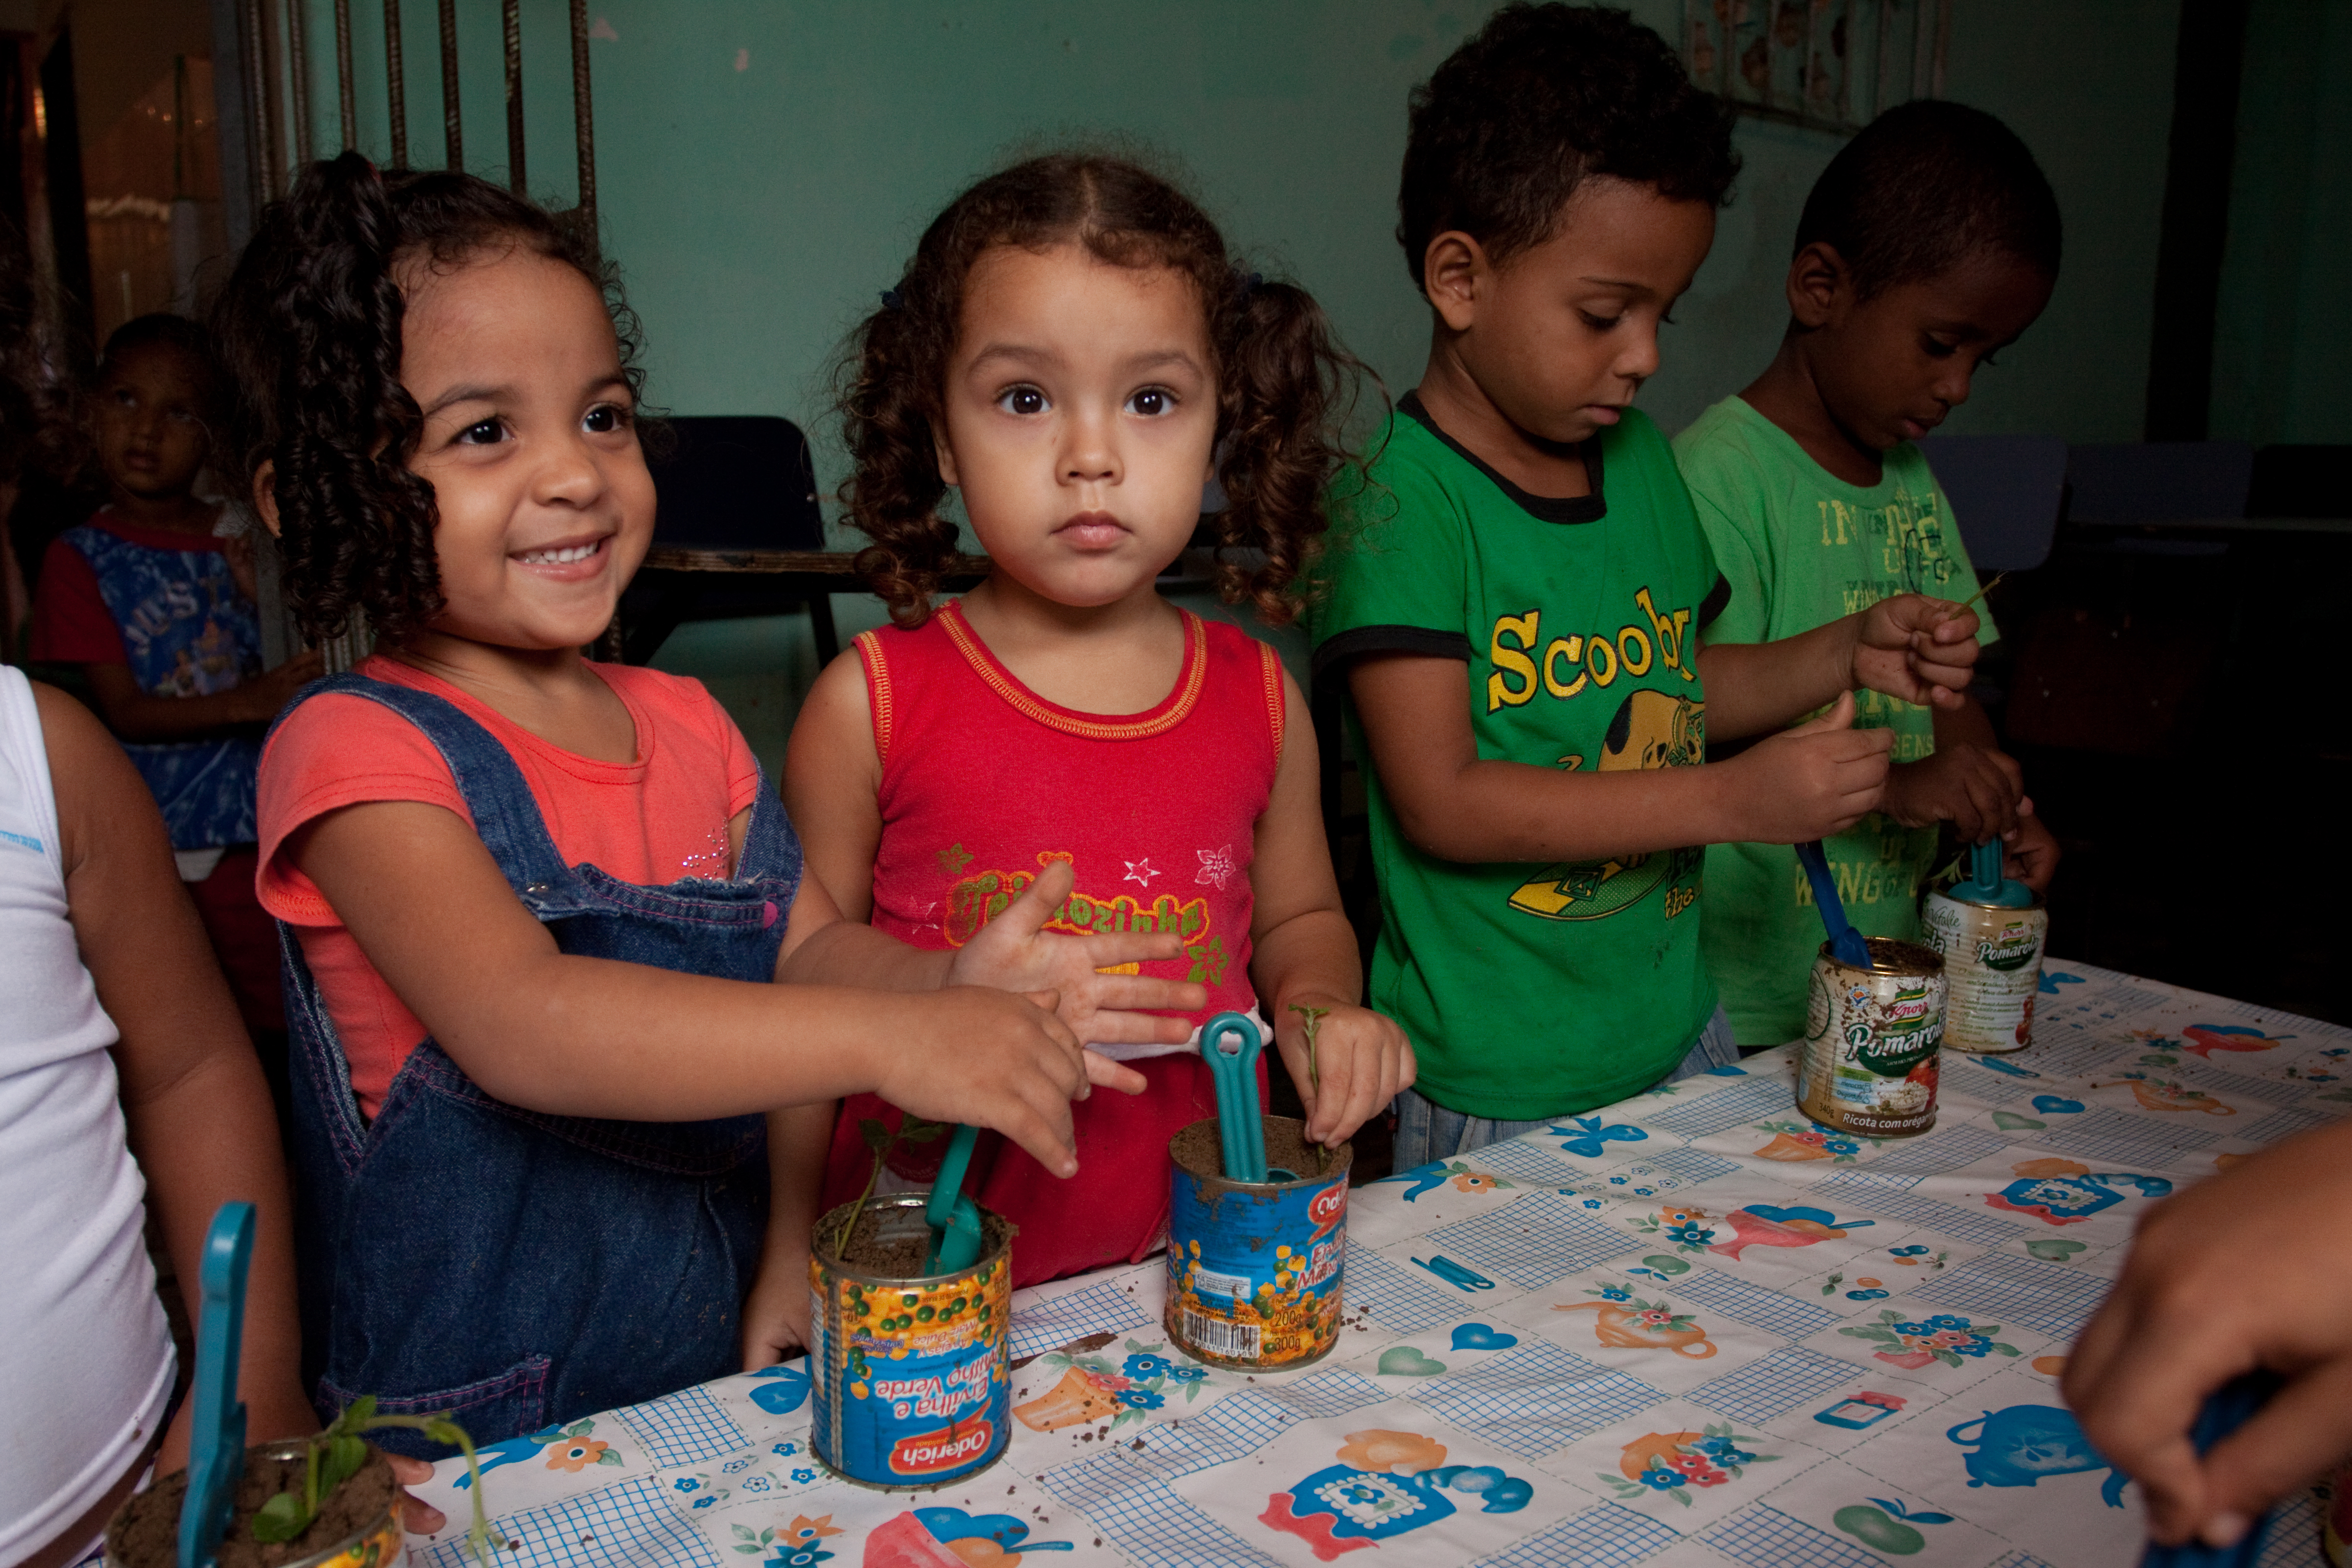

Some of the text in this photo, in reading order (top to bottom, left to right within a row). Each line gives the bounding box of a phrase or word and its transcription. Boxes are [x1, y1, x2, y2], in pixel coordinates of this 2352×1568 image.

[2002, 929, 2024, 938] Knorr
[1976, 934, 2039, 963] Pomarola
[1891, 1001, 1927, 1016] Knorr
[1818, 1103, 1834, 1119] 340g
[1843, 1113, 1877, 1127] Ricota
[1879, 1119, 1901, 1128] com
[913, 1331, 947, 1346] Dulce
[1274, 1335, 1301, 1352] 300g
[875, 1349, 998, 1401] Milho Verde
[895, 1376, 988, 1418] Ervilha e
[903, 1430, 985, 1466] Oderich
